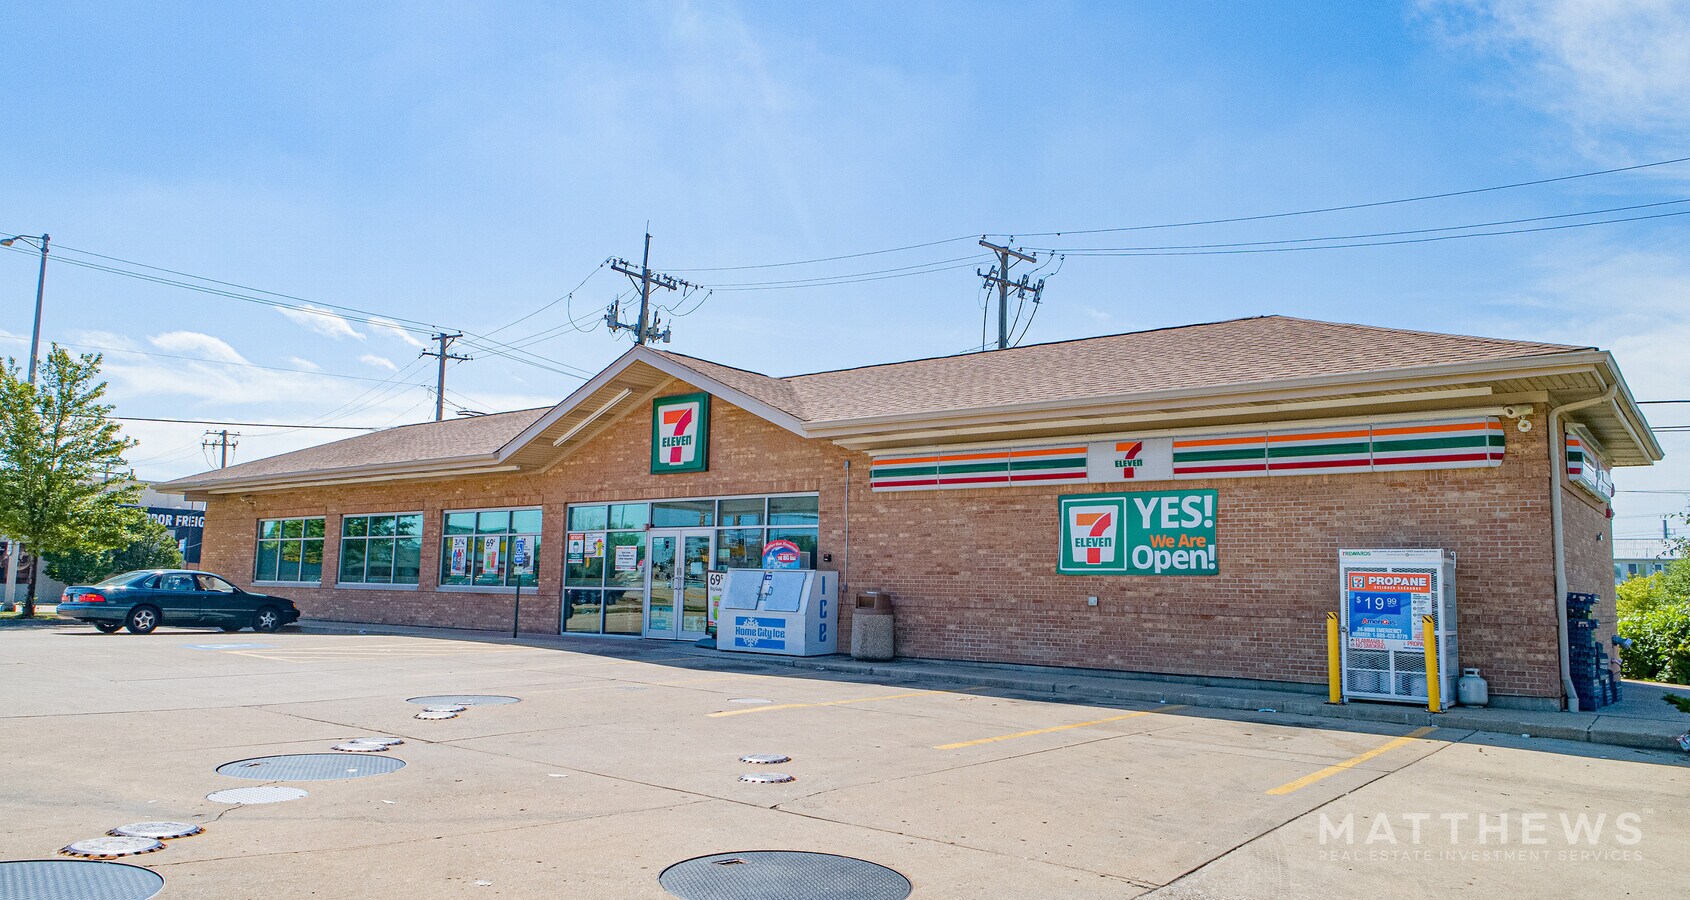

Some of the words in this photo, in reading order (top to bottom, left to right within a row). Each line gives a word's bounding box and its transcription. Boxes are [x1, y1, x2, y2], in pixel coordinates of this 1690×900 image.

[662, 435, 692, 448] ELEVEN
[664, 407, 692, 463] 7
[1115, 459, 1143, 467] ELEVEN
[1116, 441, 1143, 478] 7
[1133, 495, 1214, 529] YES!
[1075, 537, 1112, 548] ELEVEN
[1150, 534, 1175, 548] We
[1178, 534, 1206, 547] Are
[1132, 545, 1216, 574] Open!
[1368, 576, 1427, 587] PROPANE
[735, 627, 756, 637] Home
[757, 628, 772, 639] City
[773, 629, 785, 638] Ice
